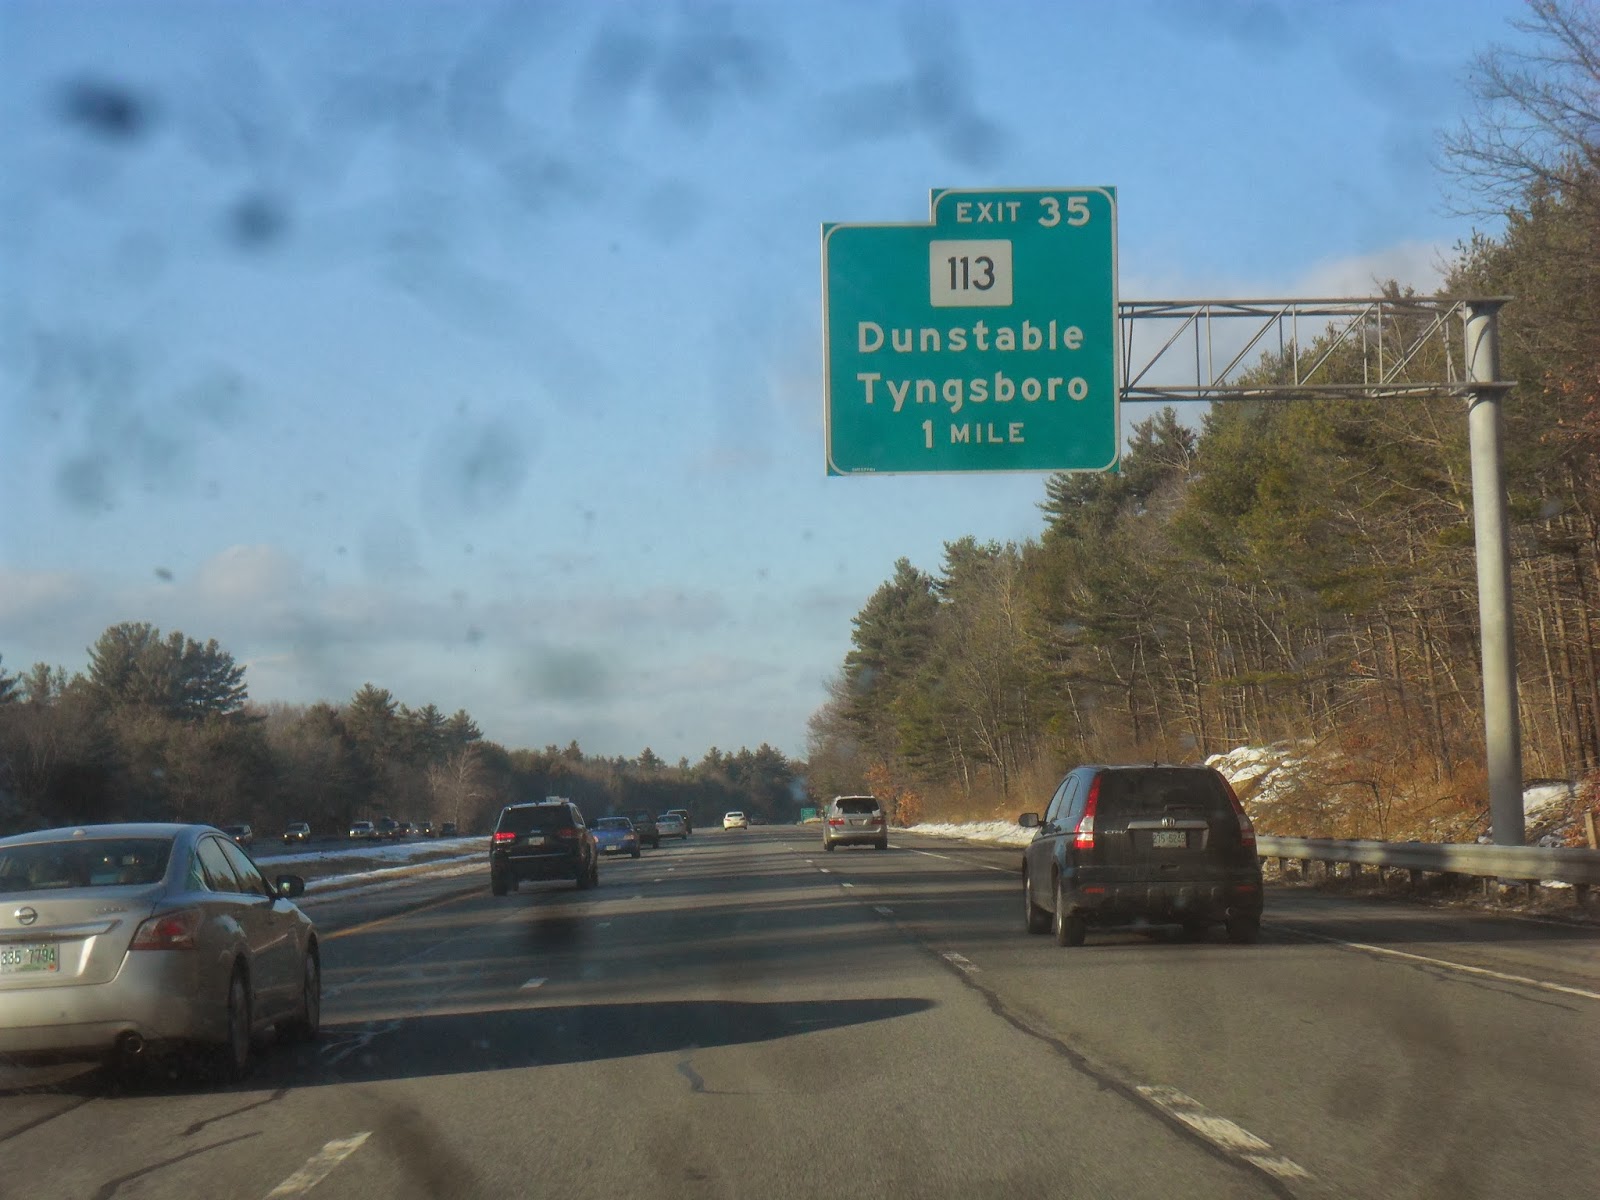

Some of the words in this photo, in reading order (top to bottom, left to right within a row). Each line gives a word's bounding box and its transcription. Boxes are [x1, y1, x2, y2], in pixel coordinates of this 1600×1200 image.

[956, 202, 1021, 222] EXIT
[1038, 196, 1091, 227] 35
[947, 256, 996, 291] 113
[857, 320, 1084, 353] Dunstable
[856, 371, 1089, 414] Tyngsboro
[922, 420, 934, 449] 1
[950, 422, 1025, 444] MILE
[0, 949, 22, 965] 335
